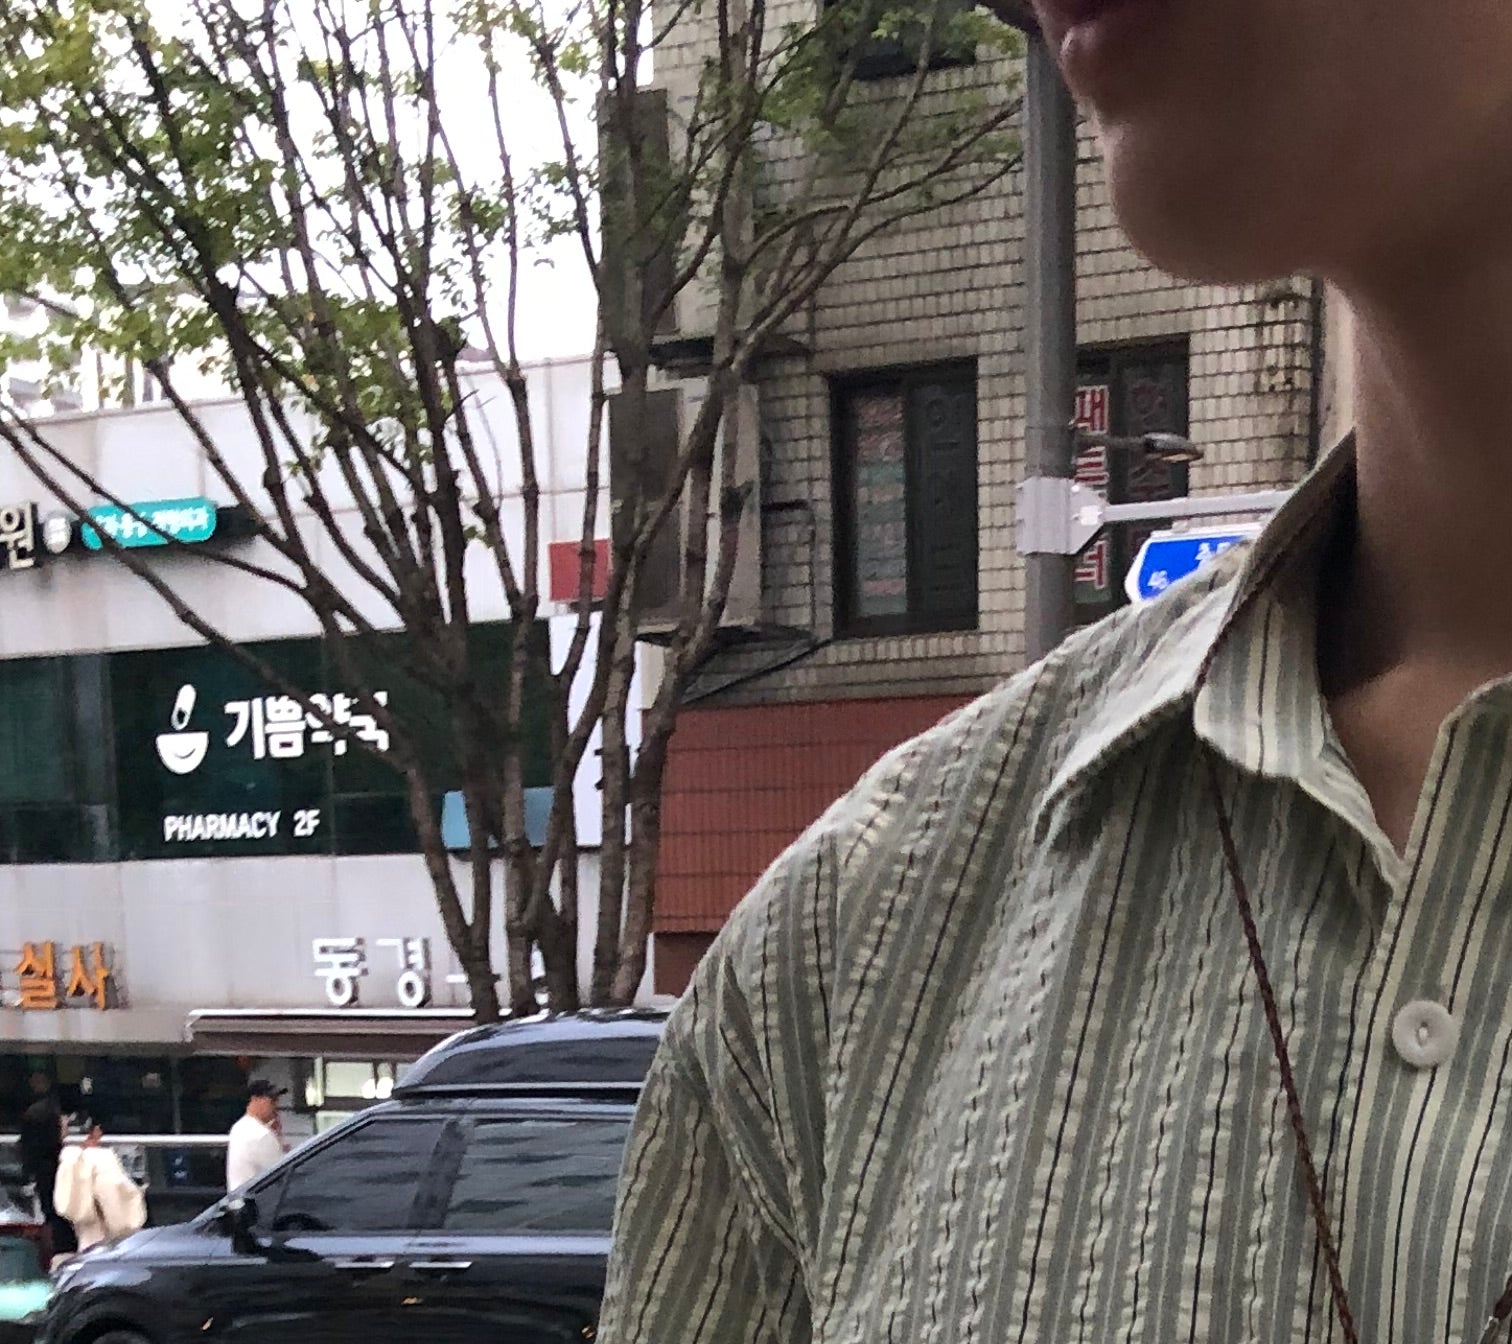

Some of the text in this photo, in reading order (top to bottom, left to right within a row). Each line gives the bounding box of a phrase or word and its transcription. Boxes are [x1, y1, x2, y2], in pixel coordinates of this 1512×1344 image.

[164, 809, 320, 842] PHARMACY 2F
[14, 940, 105, 1009] 실사
[312, 937, 468, 1006] 동경
